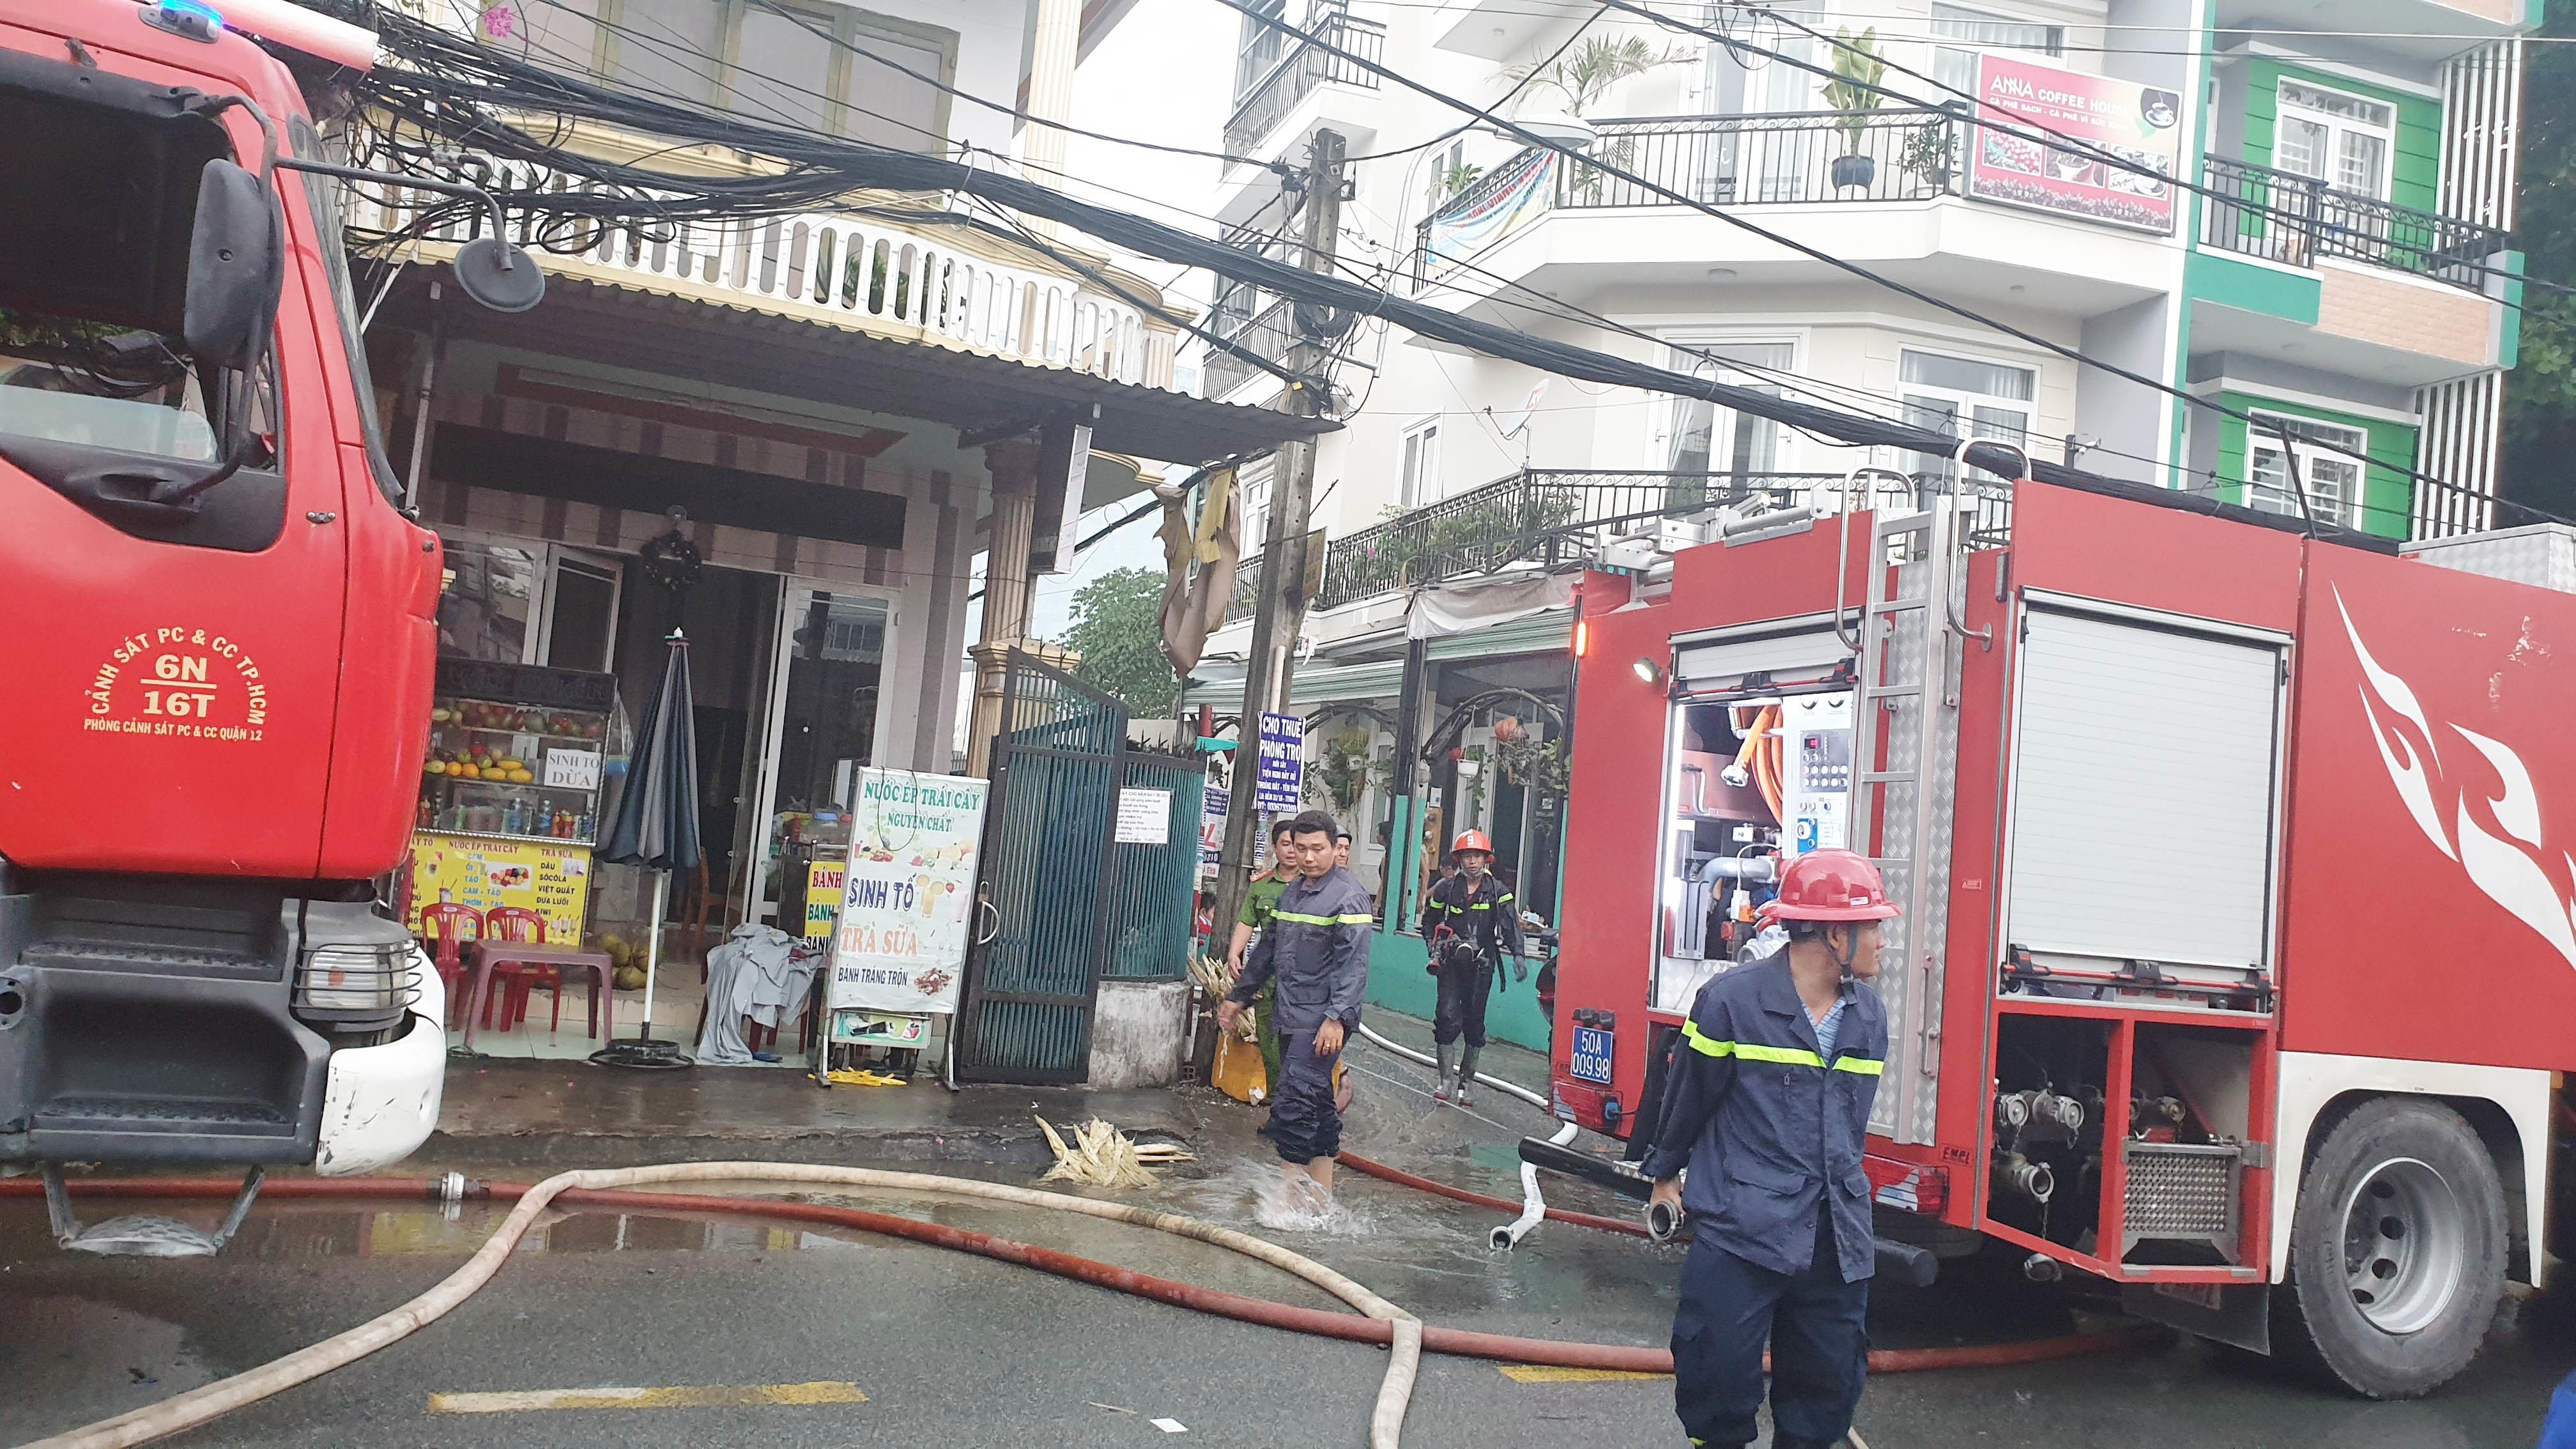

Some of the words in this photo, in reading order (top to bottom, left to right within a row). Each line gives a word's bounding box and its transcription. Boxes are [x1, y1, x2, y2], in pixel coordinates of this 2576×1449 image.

[1989, 74, 2035, 100] ANNA
[2038, 88, 2085, 109] COFFEE
[84, 663, 119, 714] CẢNH
[113, 633, 150, 663] SÁT
[157, 626, 185, 644] PC
[191, 629, 206, 646] &
[211, 636, 239, 659] CC
[155, 654, 208, 682] 6N
[142, 690, 216, 718] 16T
[84, 716, 121, 733] PHÒNG
[123, 717, 151, 734] CẢNH
[153, 720, 174, 735] SÁT
[177, 723, 191, 737] PC
[193, 724, 202, 737] &
[204, 725, 218, 739] CC
[219, 724, 247, 742] QUẬN
[249, 730, 263, 741] 12
[1262, 716, 1280, 735] CHO
[1282, 717, 1303, 738] THUÊ
[549, 754, 579, 767] SINH
[1259, 735, 1285, 760] PHÒNG
[1285, 742, 1301, 765] TRỌ
[551, 769, 591, 786] DỪA
[864, 779, 901, 801] NƯỚC
[921, 785, 952, 807] TRÁI
[954, 788, 981, 810] CÂY
[812, 866, 843, 888] BÁNH
[847, 877, 888, 909] SINH
[893, 873, 917, 912] TỐ
[808, 899, 835, 921] BÁNH
[882, 923, 917, 956] SỮA
[838, 963, 859, 983] BÁNH
[862, 965, 886, 985] TRÁNG
[888, 967, 908, 988] TRỘN
[1581, 1031, 1602, 1055] 50A
[1572, 1052, 1609, 1079] 009.98
